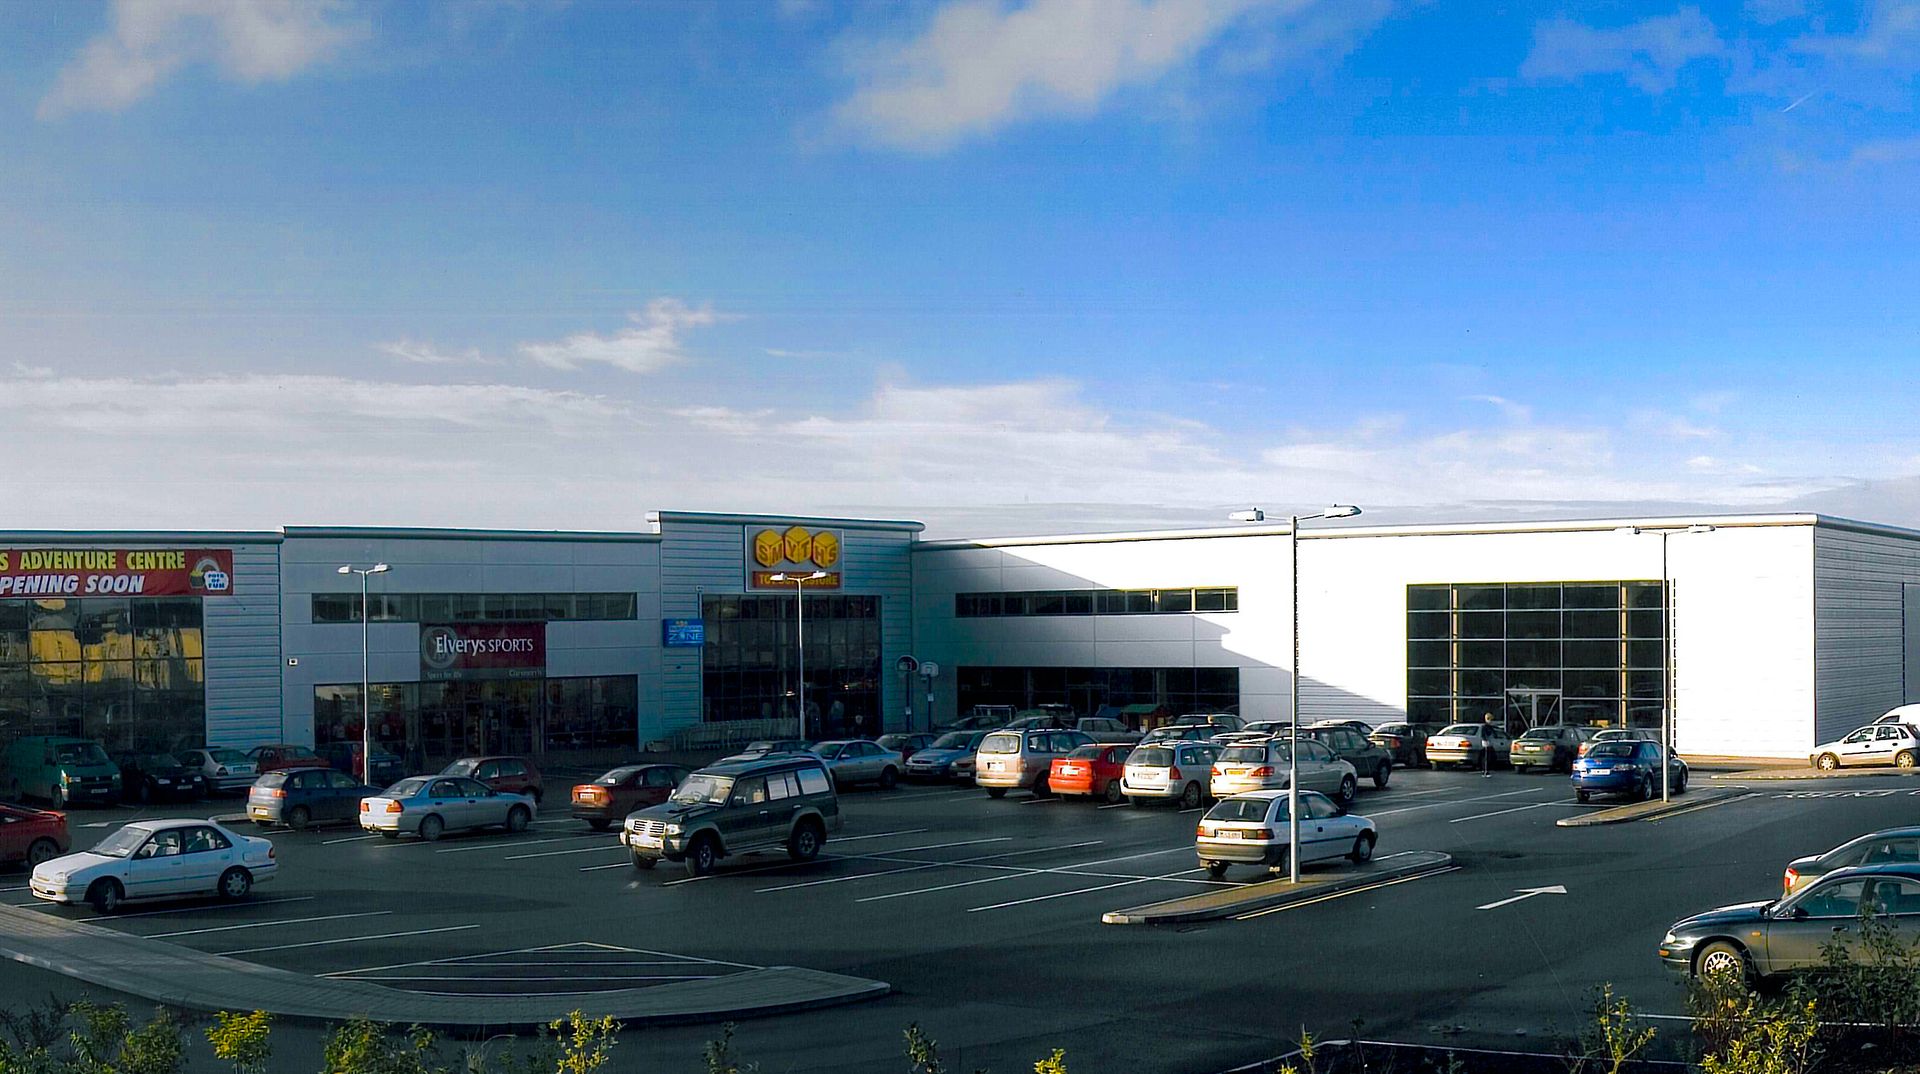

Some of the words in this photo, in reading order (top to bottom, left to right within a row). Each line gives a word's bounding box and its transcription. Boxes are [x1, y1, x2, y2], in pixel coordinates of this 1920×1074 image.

[20, 551, 117, 570] ADVENTURE
[126, 551, 186, 570] CENTRE
[758, 539, 838, 564] SMYTHS
[85, 574, 146, 593] SOON
[435, 634, 486, 657] Elverys
[488, 638, 534, 653] SPORTS
